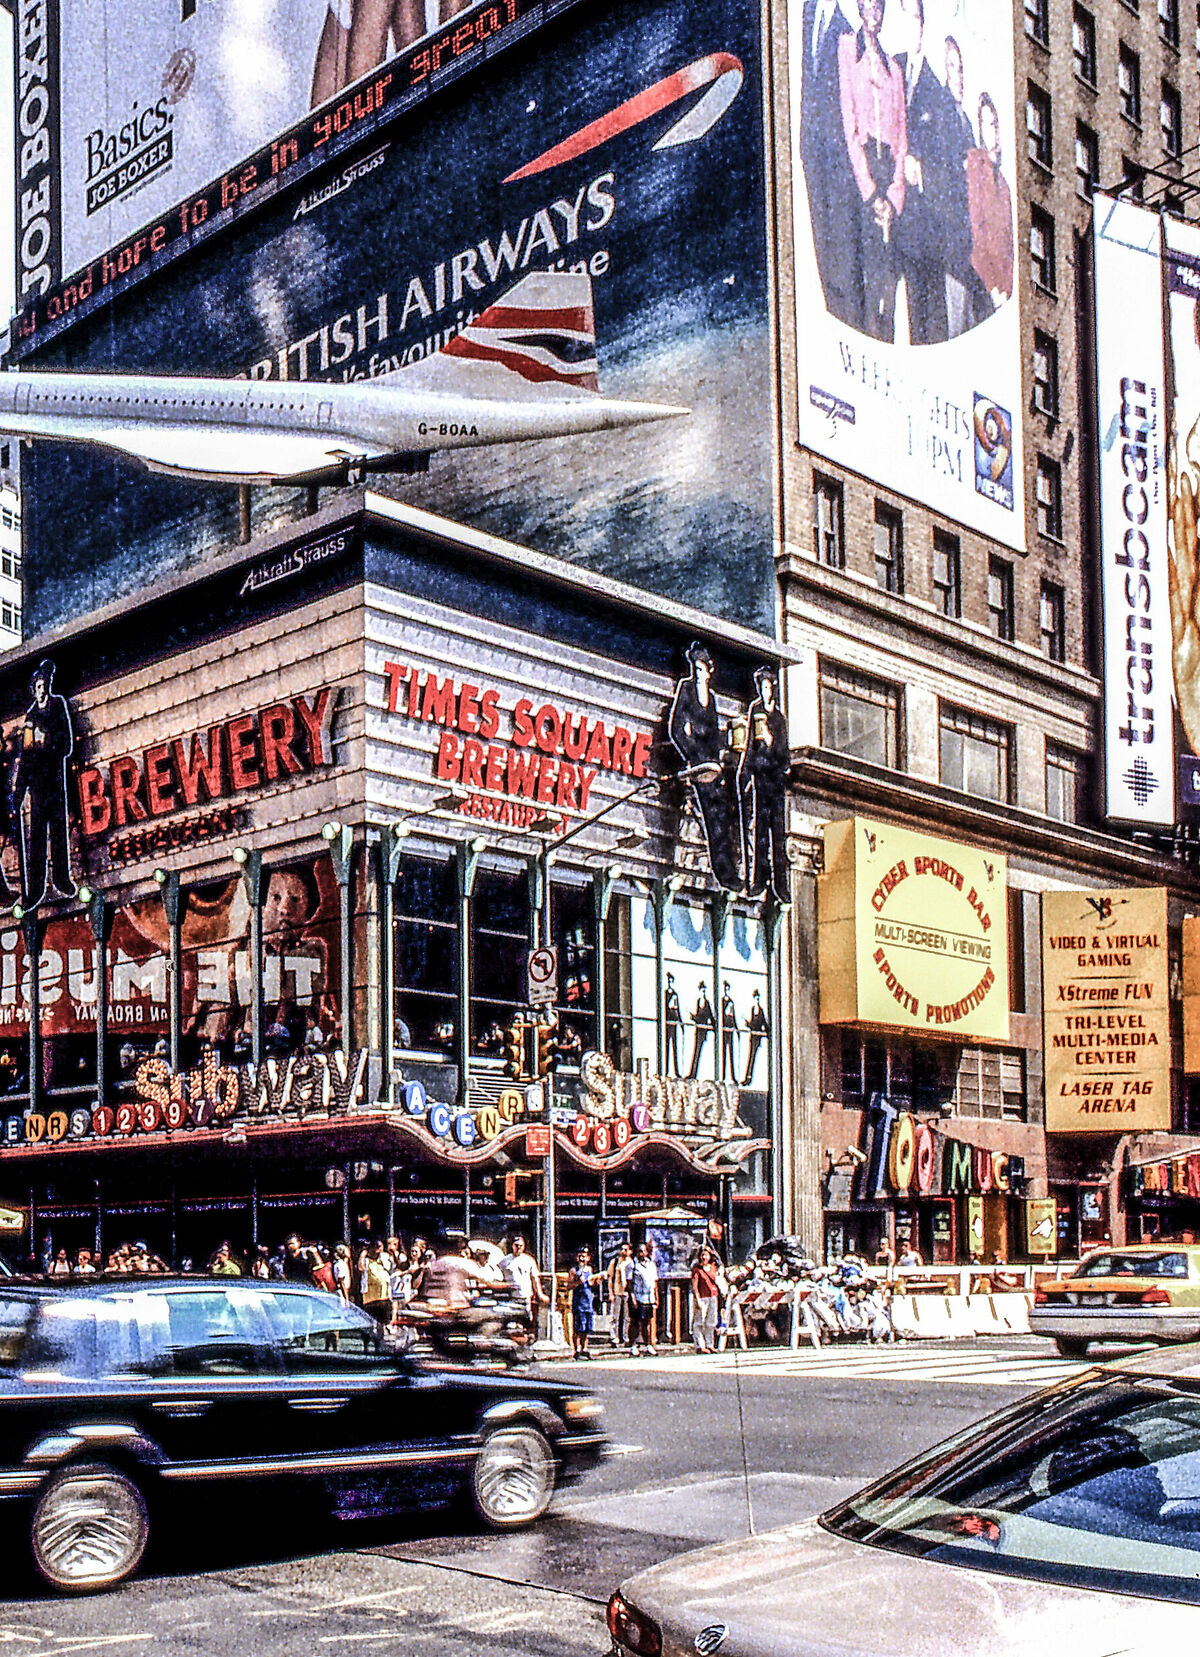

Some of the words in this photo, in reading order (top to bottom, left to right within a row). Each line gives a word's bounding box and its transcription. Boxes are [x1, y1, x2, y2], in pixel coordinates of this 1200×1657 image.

[19, 0, 50, 179] BOXE
[47, 267, 93, 319] and
[102, 226, 166, 285] hope
[179, 199, 208, 233] to
[221, 164, 258, 208] be
[271, 139, 298, 175] in
[313, 73, 392, 148] your
[89, 176, 115, 208] JOE
[118, 141, 169, 188] BOXER
[21, 174, 51, 294] JOE
[233, 293, 389, 382] RITISH
[401, 172, 615, 331] AIRWAYS
[418, 422, 479, 436] G-BOAA
[293, 536, 345, 572] Strauss
[384, 661, 500, 740] TIMES
[512, 699, 654, 778] SQUARE
[80, 686, 333, 836] BREWERY
[437, 732, 598, 811] BREWERY
[871, 860, 909, 912] CYBER
[966, 886, 992, 933] BAR
[875, 922, 948, 950] MULTI-SCREEN
[952, 938, 992, 960] VIEWING
[1050, 936, 1086, 950] VIDEO
[1092, 936, 1101, 949] &
[1106, 934, 1160, 949] VIRTUAL
[1077, 953, 1131, 967] GAMING
[925, 966, 996, 1025] PROMOTIONS
[1057, 984, 1119, 1001] XStreme
[1125, 983, 1154, 1000] FUN
[1052, 1032, 1159, 1048] MULTI-MEDIA
[1064, 1015, 1147, 1030] TRI-LEVEL
[1075, 1051, 1137, 1065] CENTER
[1059, 1081, 1114, 1096] LASER
[1122, 1081, 1154, 1096] TAG
[1078, 1099, 1137, 1113] ARENA
[7, 1121, 18, 1140] E
[29, 1119, 42, 1138] N
[50, 1117, 61, 1137] R
[72, 1114, 85, 1134] S
[119, 1109, 131, 1130] 2
[143, 1105, 155, 1126] 3
[168, 1102, 180, 1125] 9
[195, 1100, 206, 1122] 7
[409, 1086, 424, 1111] A
[434, 1111, 450, 1133] C
[461, 1117, 473, 1142] E
[485, 1114, 496, 1134] N
[507, 1095, 518, 1120] R
[576, 1119, 587, 1142] 2
[597, 1128, 608, 1150] 3
[617, 1122, 628, 1145] 9
[637, 1107, 647, 1127] 7
[868, 1091, 935, 1195] TOO
